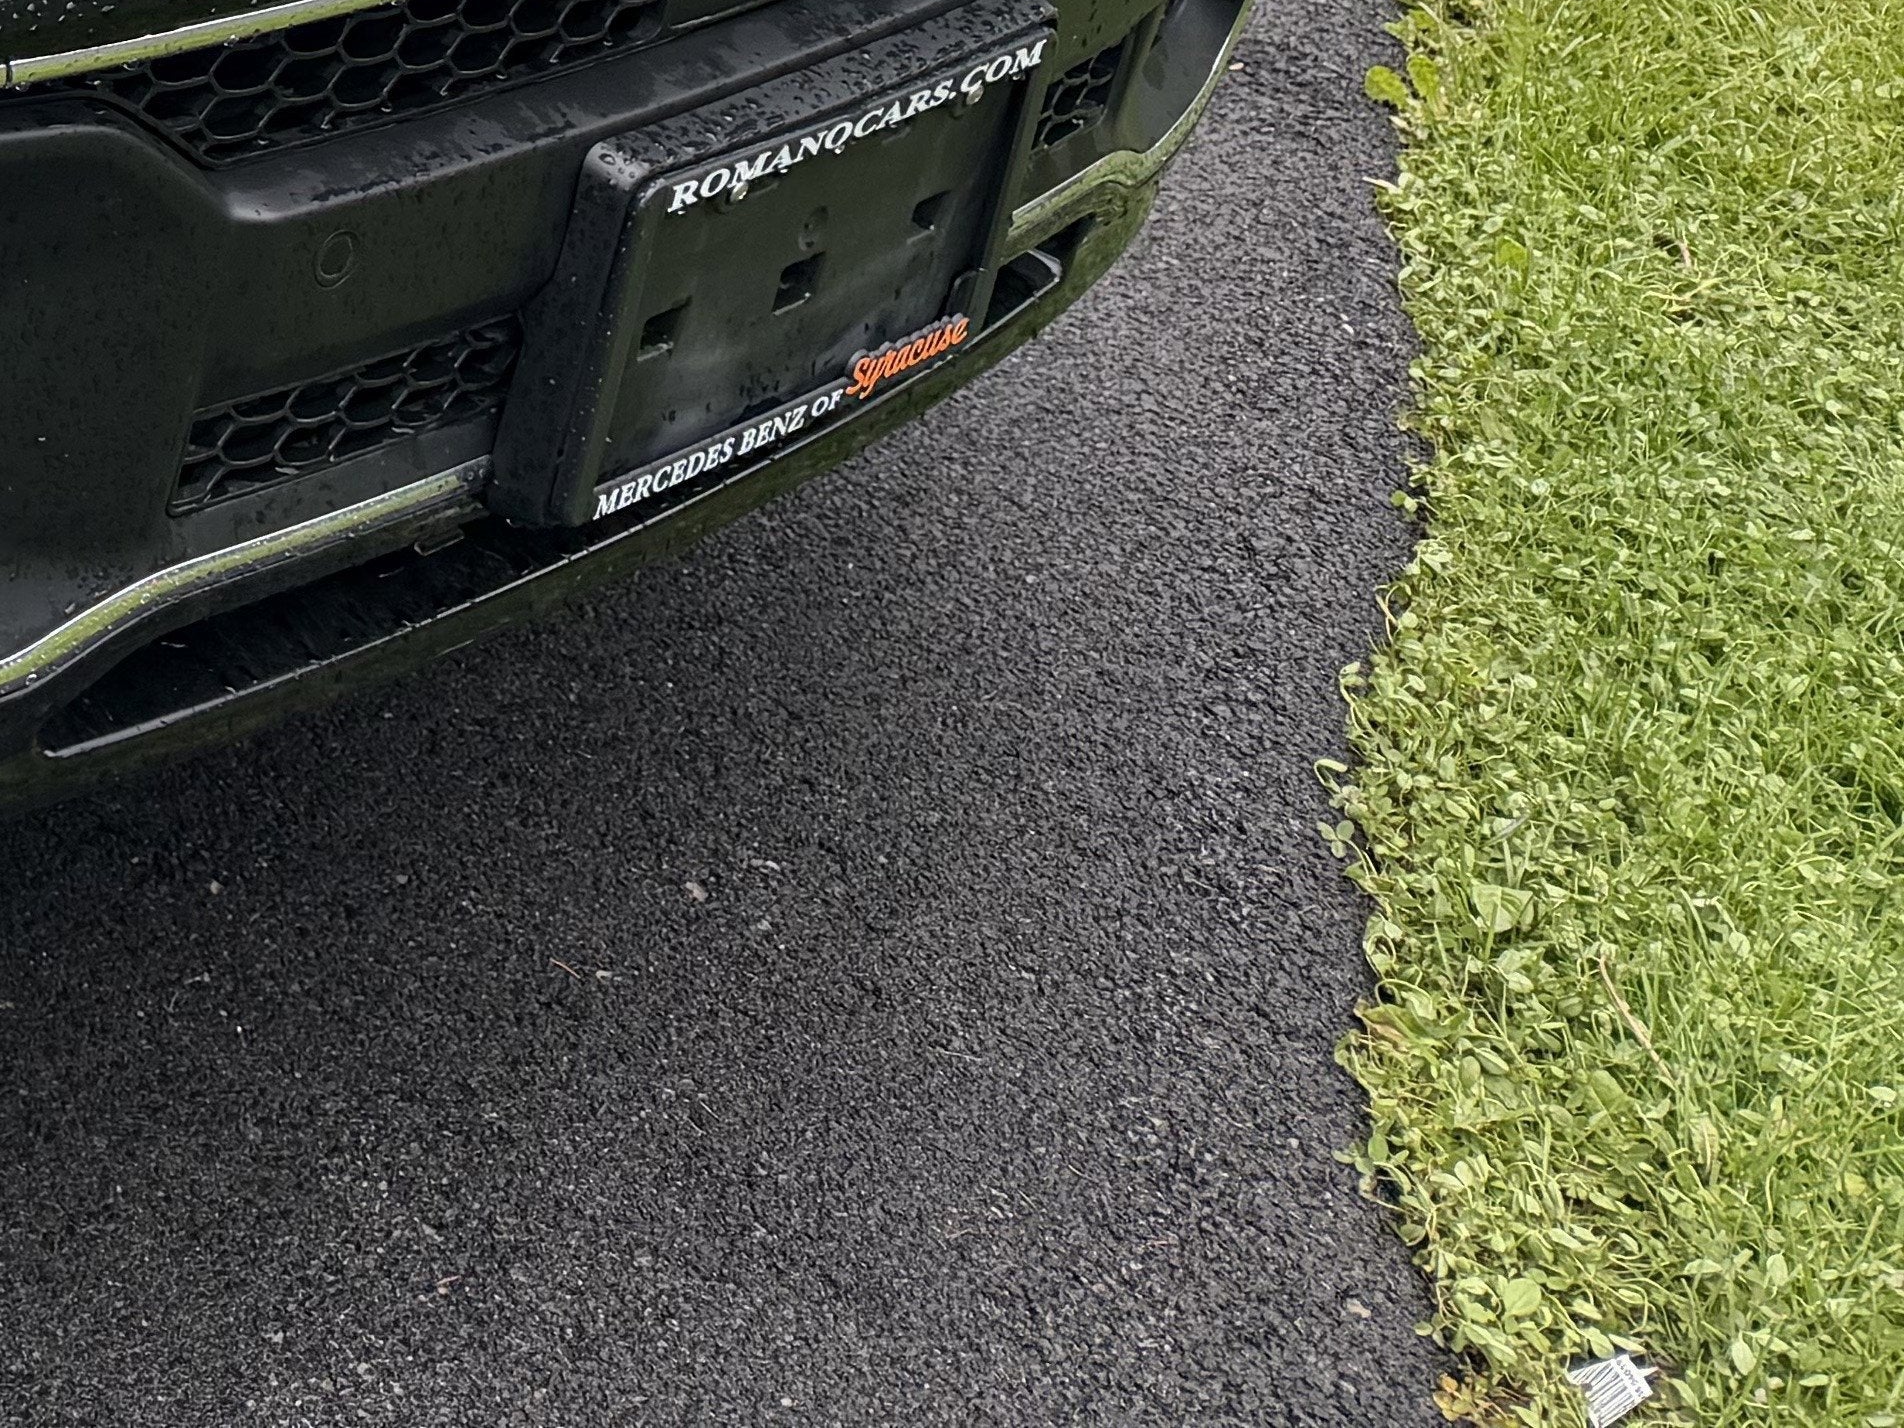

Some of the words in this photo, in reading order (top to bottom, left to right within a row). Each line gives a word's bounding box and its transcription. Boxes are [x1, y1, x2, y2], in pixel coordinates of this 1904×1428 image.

[666, 38, 1048, 214] ROMANOCARS.COM
[592, 442, 735, 521] MERCEDES
[737, 412, 806, 457] BENZ
[811, 388, 845, 419] OF
[845, 315, 970, 400] Syracuse
